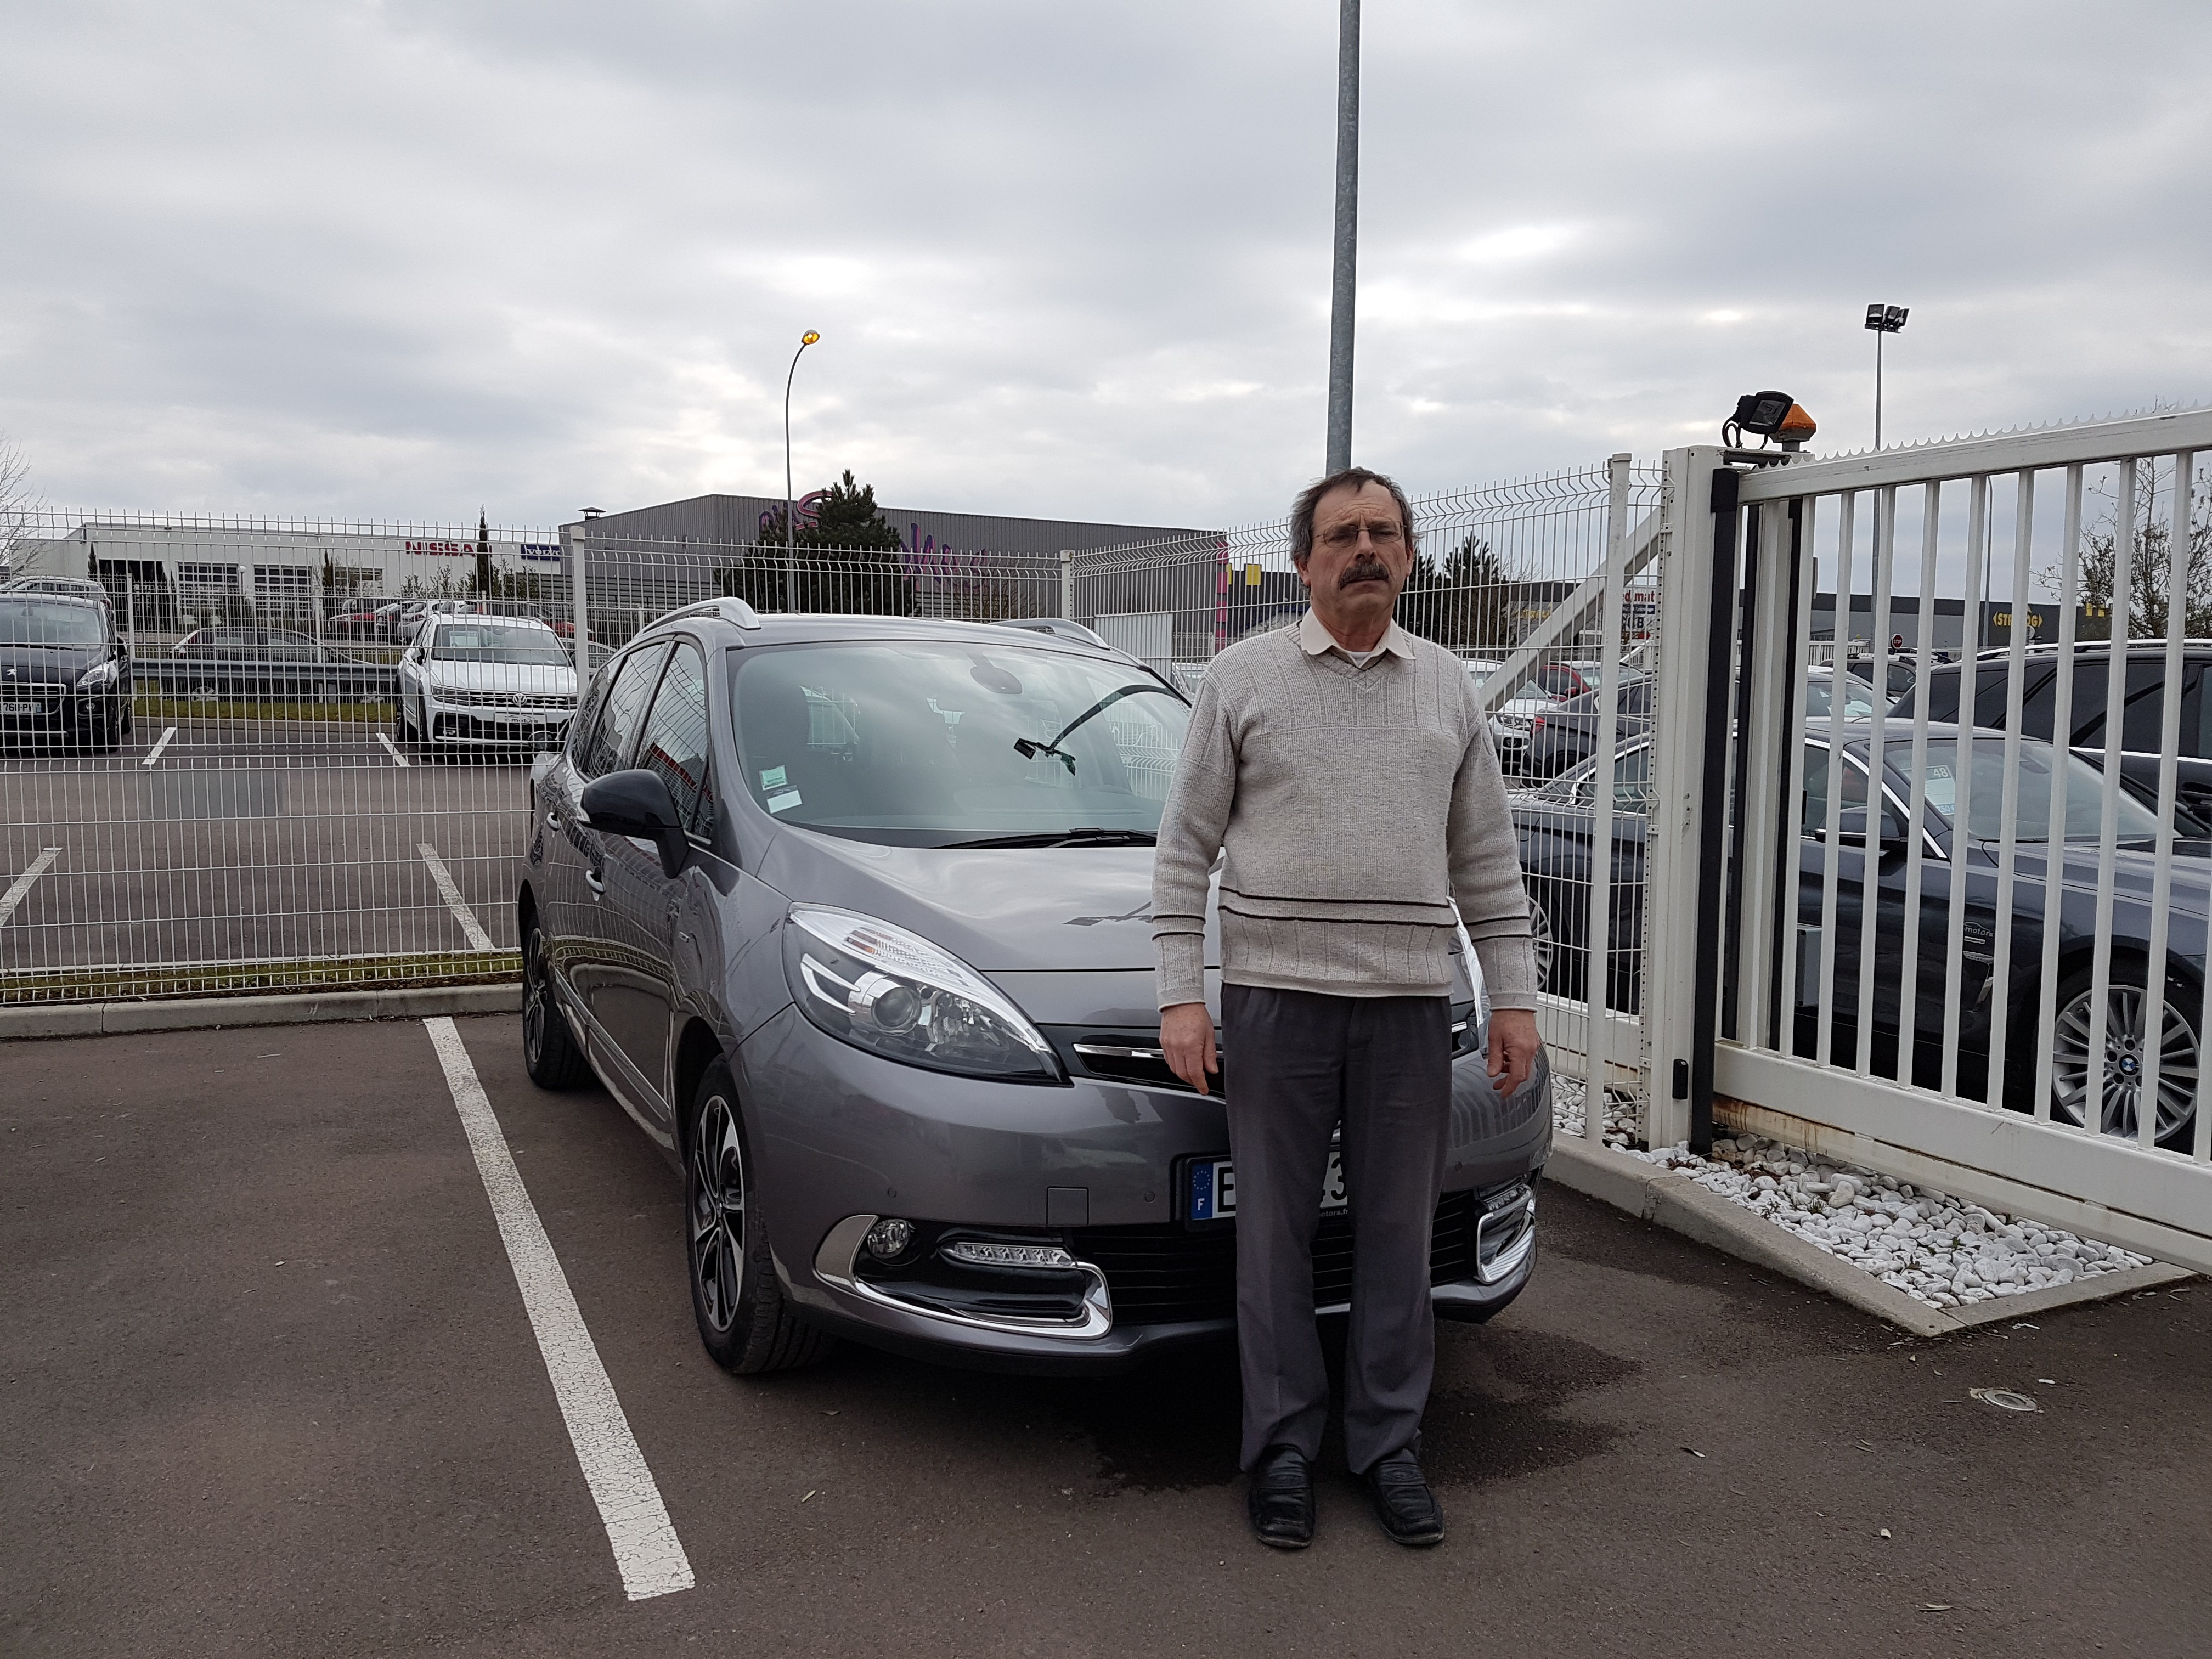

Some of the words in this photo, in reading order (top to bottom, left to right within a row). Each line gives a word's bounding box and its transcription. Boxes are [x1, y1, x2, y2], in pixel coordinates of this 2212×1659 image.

[405, 541, 493, 558] NISSA
[1934, 768, 1949, 778] 48
[1198, 1198, 1205, 1211] F
